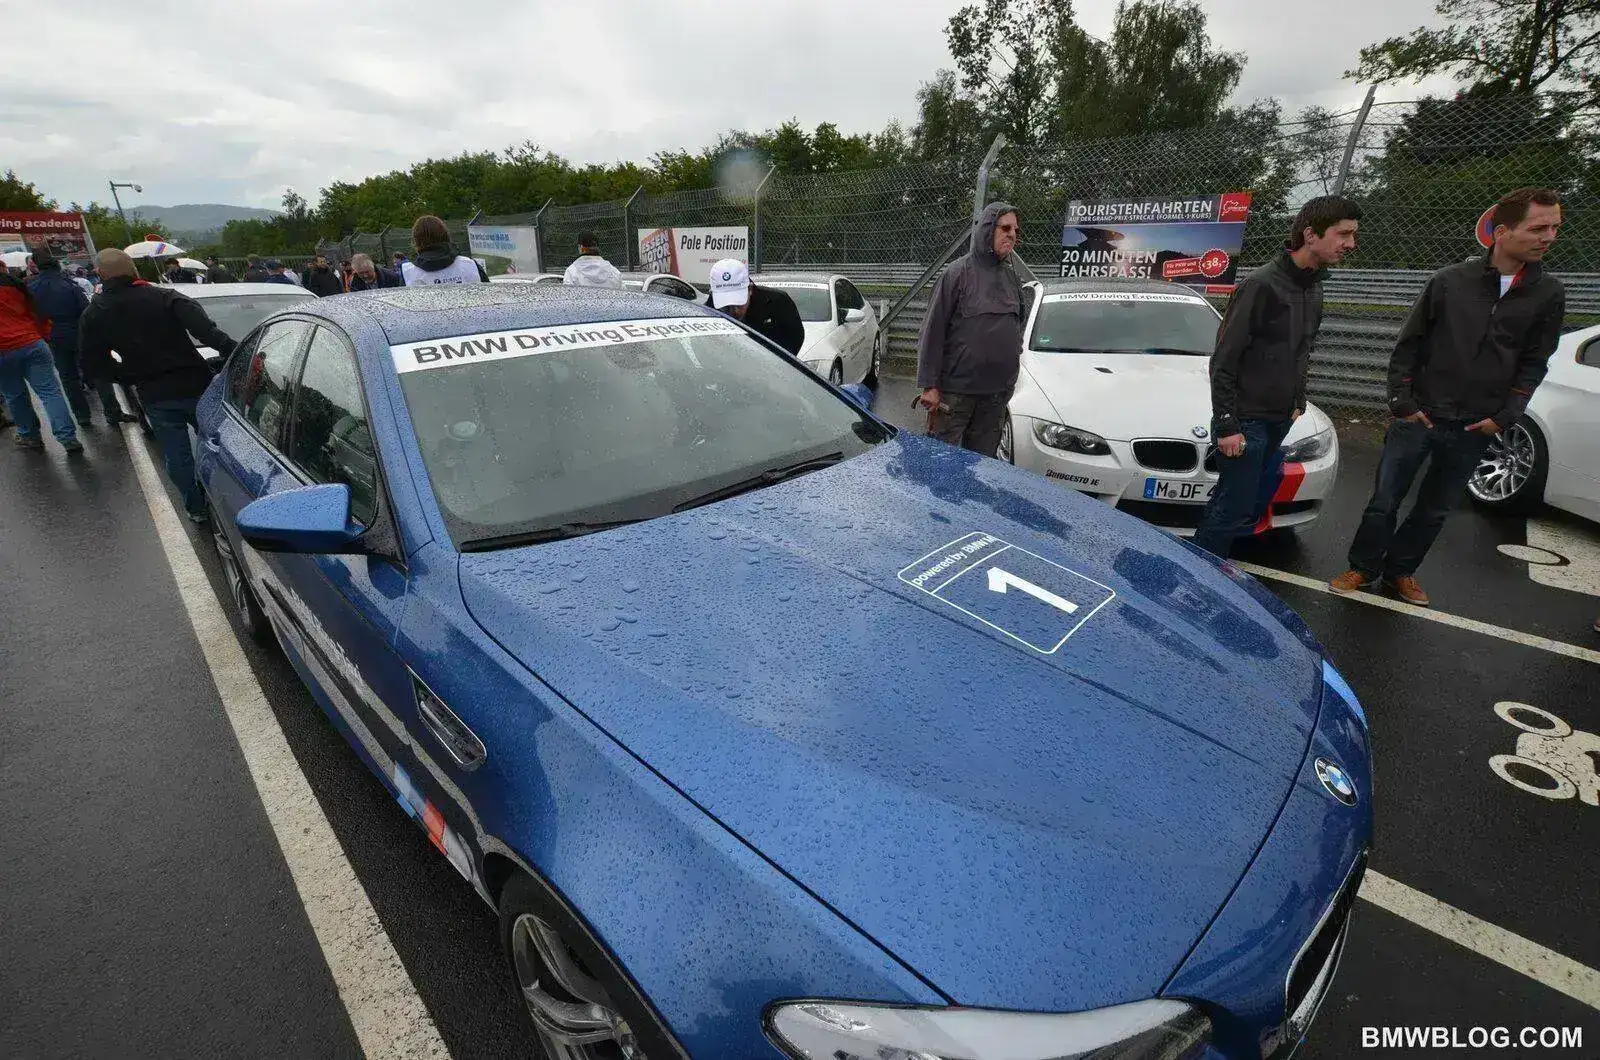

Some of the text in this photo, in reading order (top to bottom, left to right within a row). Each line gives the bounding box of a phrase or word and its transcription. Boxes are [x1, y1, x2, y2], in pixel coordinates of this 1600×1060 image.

[1069, 200, 1213, 216] TOURISTENFAHRTEN
[0, 218, 81, 230] ing academy
[681, 234, 746, 251] Pole Position
[1061, 250, 1158, 264] 20 MINUTEN
[1060, 264, 1152, 279] FAHRSPASS!
[412, 337, 508, 364] BMW
[513, 328, 624, 350] Driving
[1155, 481, 1169, 498] M
[1180, 483, 1204, 499] DF
[912, 556, 956, 587] powered
[961, 538, 988, 554] BMW
[986, 566, 1080, 615] 1
